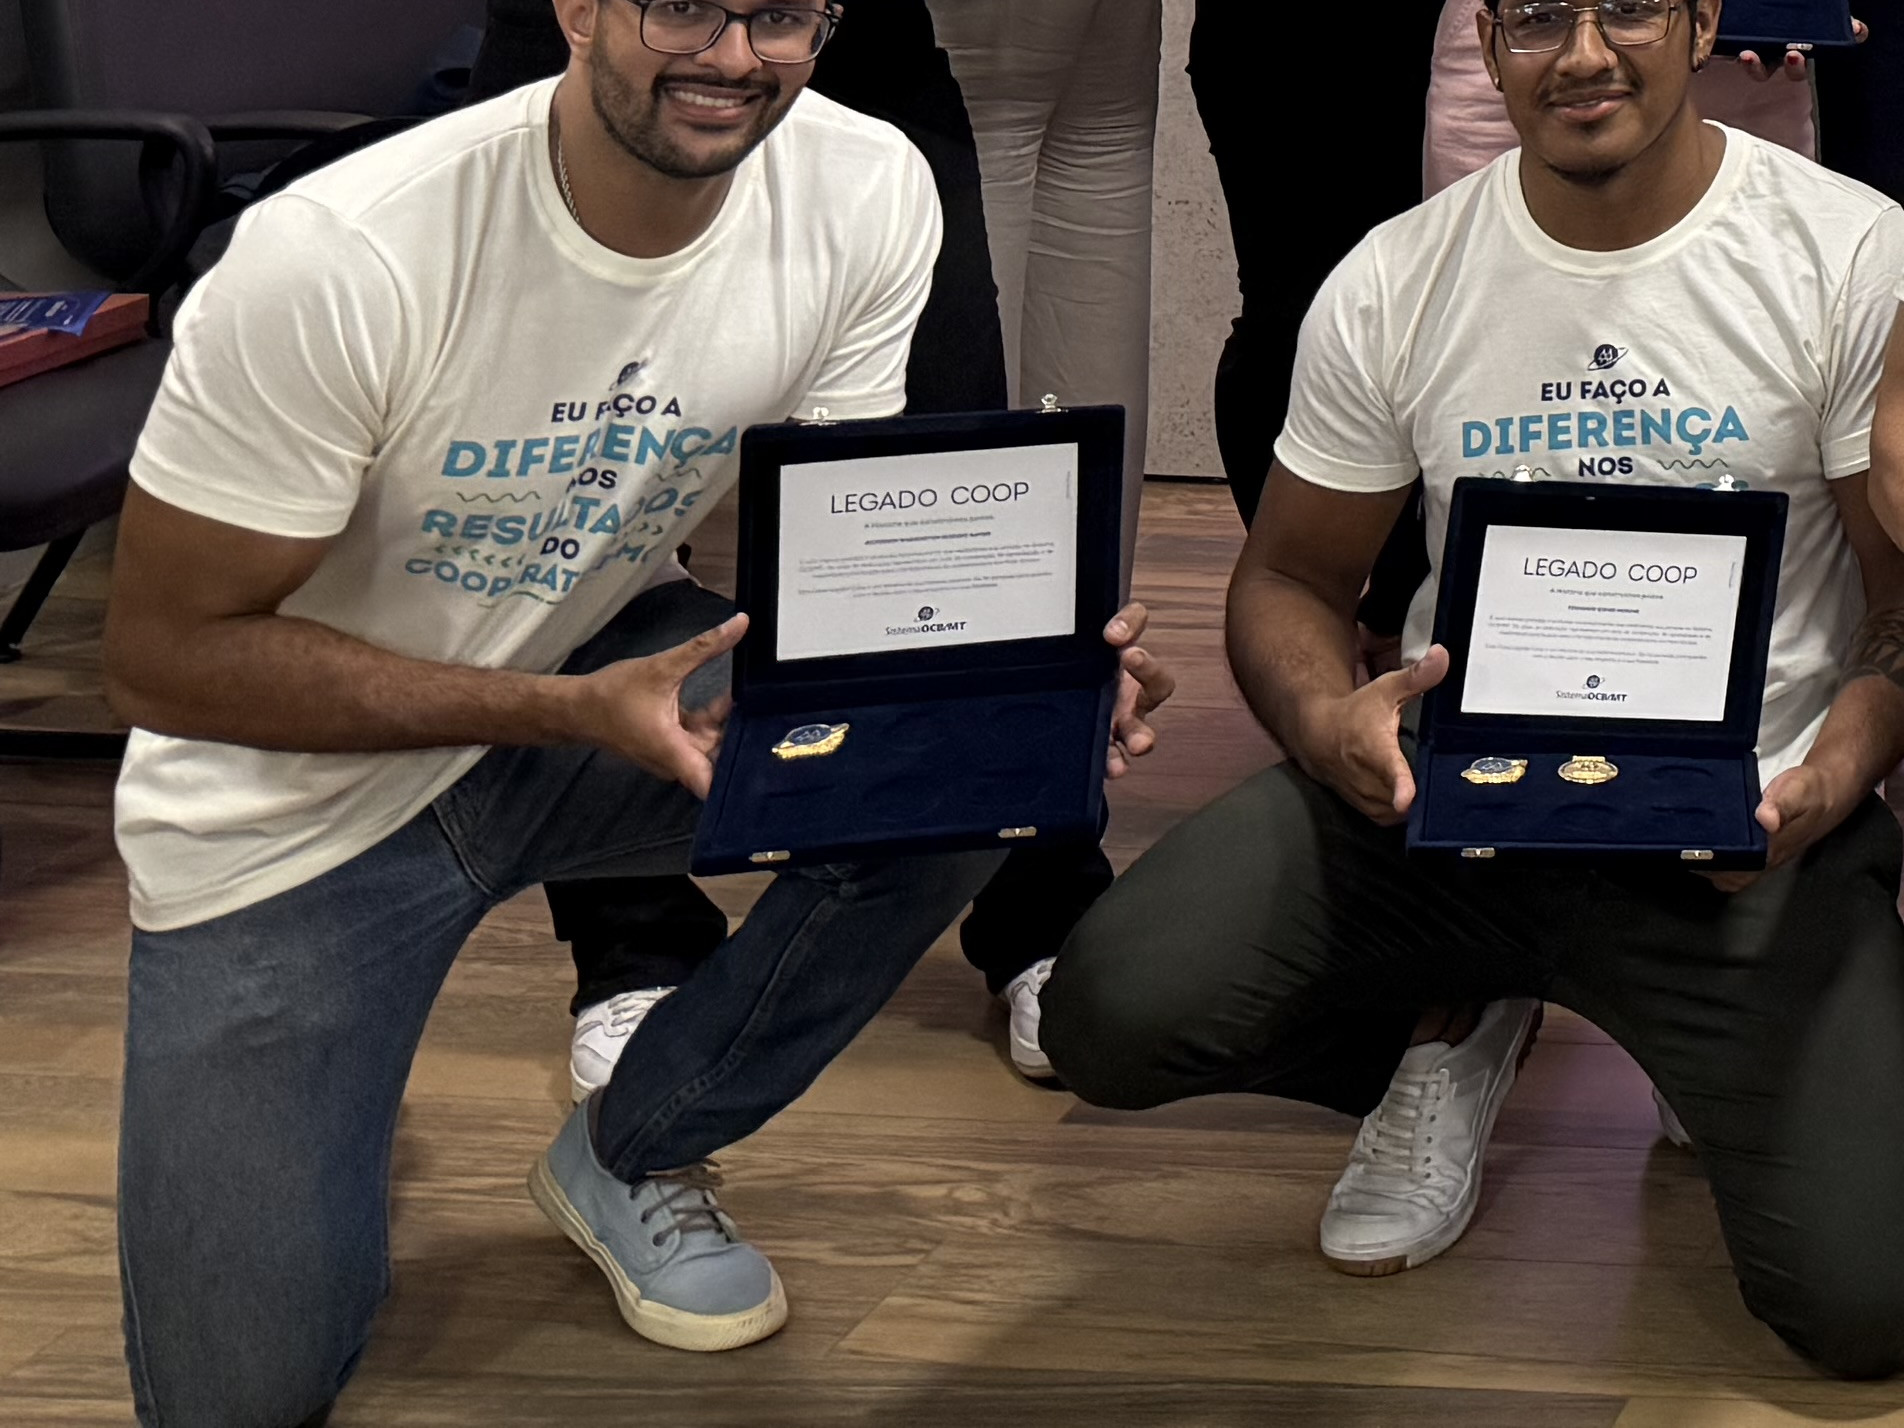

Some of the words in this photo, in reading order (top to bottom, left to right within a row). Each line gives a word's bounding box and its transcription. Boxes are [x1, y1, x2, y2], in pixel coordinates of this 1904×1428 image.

[1541, 382, 1572, 402] EU
[1580, 379, 1647, 404] FAÇO
[1652, 378, 1670, 396] A
[551, 401, 587, 423] EU
[661, 396, 682, 418] A
[1462, 405, 1749, 458] DIFERENÇA
[1578, 456, 1633, 477] NOS
[831, 488, 937, 514] LEGADO
[951, 482, 1029, 505] COOP
[540, 537, 580, 560] DO
[1524, 558, 1617, 579] LEGADO
[1628, 564, 1697, 584] COOP
